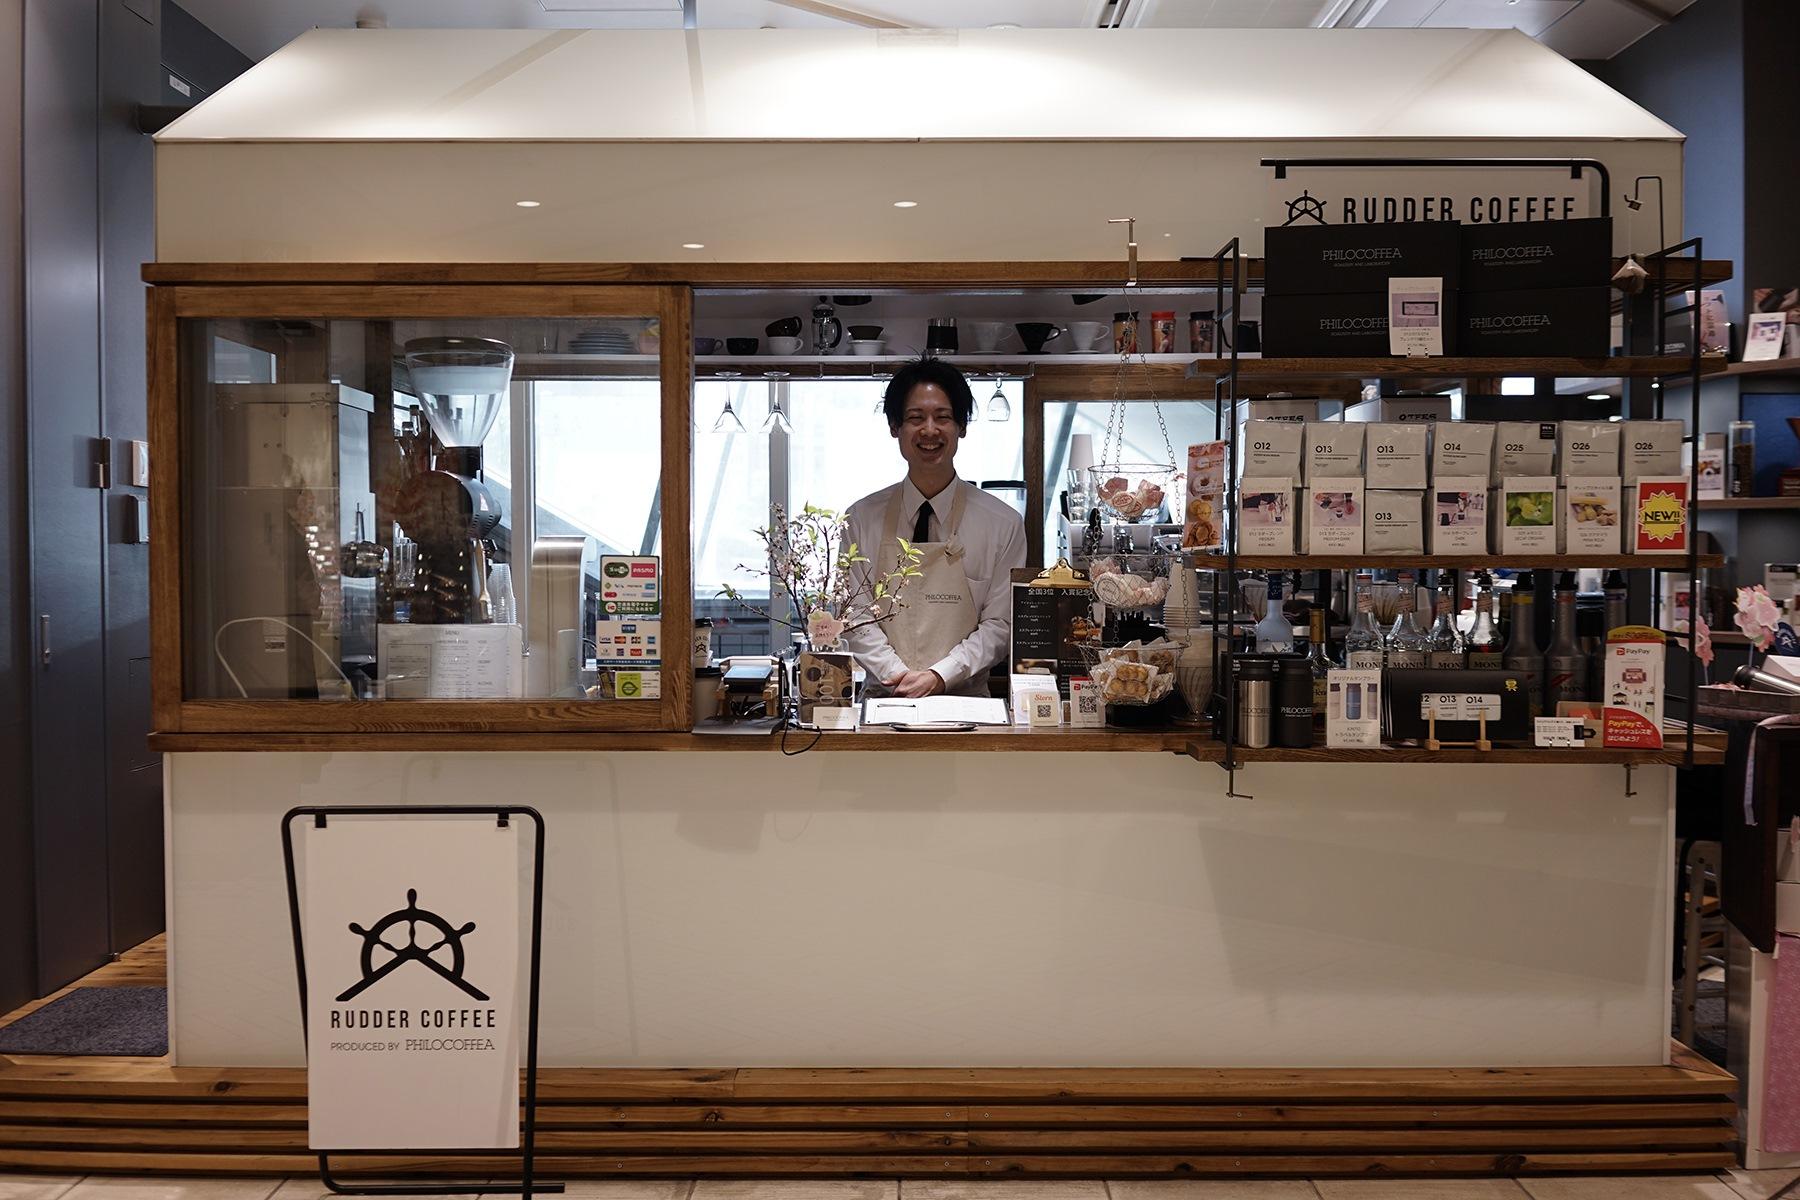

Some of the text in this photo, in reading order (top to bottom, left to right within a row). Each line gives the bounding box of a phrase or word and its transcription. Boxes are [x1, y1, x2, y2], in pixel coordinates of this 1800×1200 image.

[1343, 197, 1453, 223] RUDDER
[1322, 248, 1402, 261] PHILOCOFFEA
[1472, 245, 1554, 260] PHILOCOFFEA
[1320, 317, 1388, 329] PHILOCOFFE
[1470, 315, 1551, 328] PHILOCOFFEA
[330, 1009, 496, 1028] RUDDER COFFEE
[330, 1038, 495, 1051] PRODUCED BY PHILOCOFFEA
